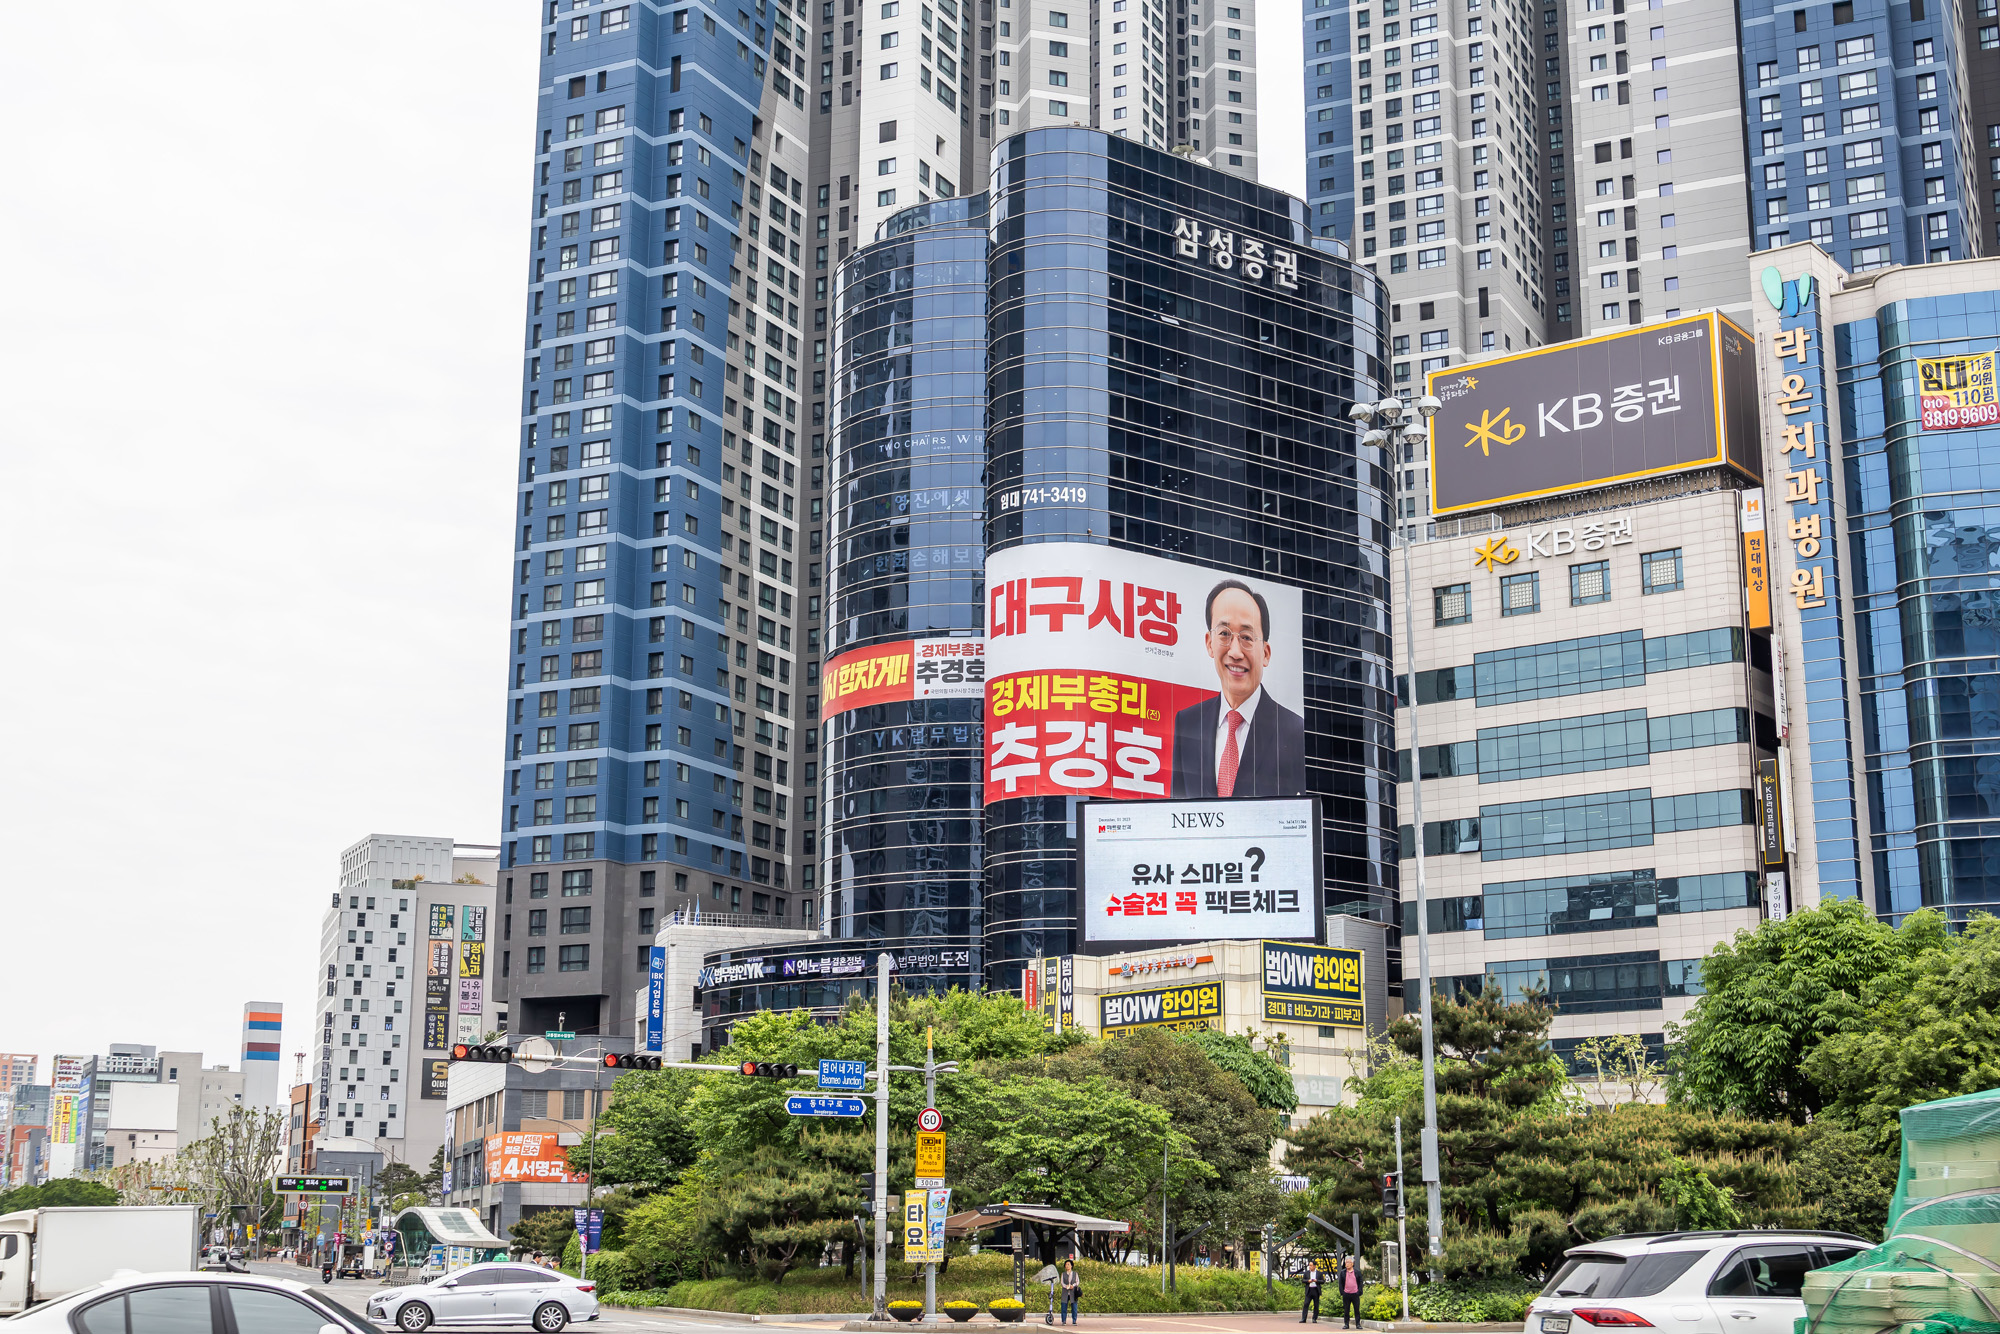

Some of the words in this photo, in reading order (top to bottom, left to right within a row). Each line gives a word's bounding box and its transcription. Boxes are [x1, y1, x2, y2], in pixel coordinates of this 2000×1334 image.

[1174, 217, 1299, 291] 삼성증권
[1921, 360, 1967, 391] 임대
[1969, 356, 1992, 372] 11층
[1971, 371, 1993, 387] 의원
[1537, 374, 1681, 438] KB증권
[1953, 386, 1995, 406] 110평
[879, 440, 901, 453] TWO
[1773, 326, 1827, 609] 라온치과병원
[1001, 491, 1020, 511] 임대
[1022, 486, 1087, 505] 741-3419
[1527, 516, 1633, 560] KB증권
[1750, 538, 1764, 592] 현대해상
[990, 576, 1182, 646] 대구시장
[839, 654, 910, 697] 힘차게!
[916, 659, 985, 685] 추경호
[990, 721, 1165, 796] 추경호
[1171, 812, 1225, 828] NEWS
[1132, 863, 1175, 885] 유사
[1180, 846, 1266, 884] 스마일?
[1104, 892, 1167, 917] 수술전
[1174, 891, 1198, 915] 꼭
[1205, 889, 1300, 914] 팩트체크
[470, 943, 481, 975] 정신과
[796, 957, 831, 975] 엔노블
[832, 956, 862, 966] 결혼정보
[898, 953, 938, 968] 법무법인
[939, 951, 970, 967] 도전
[1133, 955, 1185, 975] 북창동순두부
[1265, 950, 1359, 993] 범어W한의원
[651, 972, 664, 980] IBK
[652, 980, 661, 1018] 기업은행
[1105, 986, 1218, 1025] 범어W한의원
[1267, 1001, 1287, 1015] 경대
[436, 1014, 445, 1048] 비뇨의학과
[821, 1074, 841, 1084] Beomeo
[842, 1075, 862, 1086] Junction
[822, 1062, 863, 1075] 범어네거리
[809, 1099, 843, 1108] 동대구로
[923, 1115, 937, 1125] 60
[506, 1135, 523, 1144] 다른
[524, 1135, 541, 1145] 선택
[521, 1146, 539, 1155] 보수
[503, 1157, 520, 1178] 4
[520, 1160, 564, 1177] 서명교
[907, 1203, 924, 1246] 타요
[478, 1252, 484, 1262] 7
